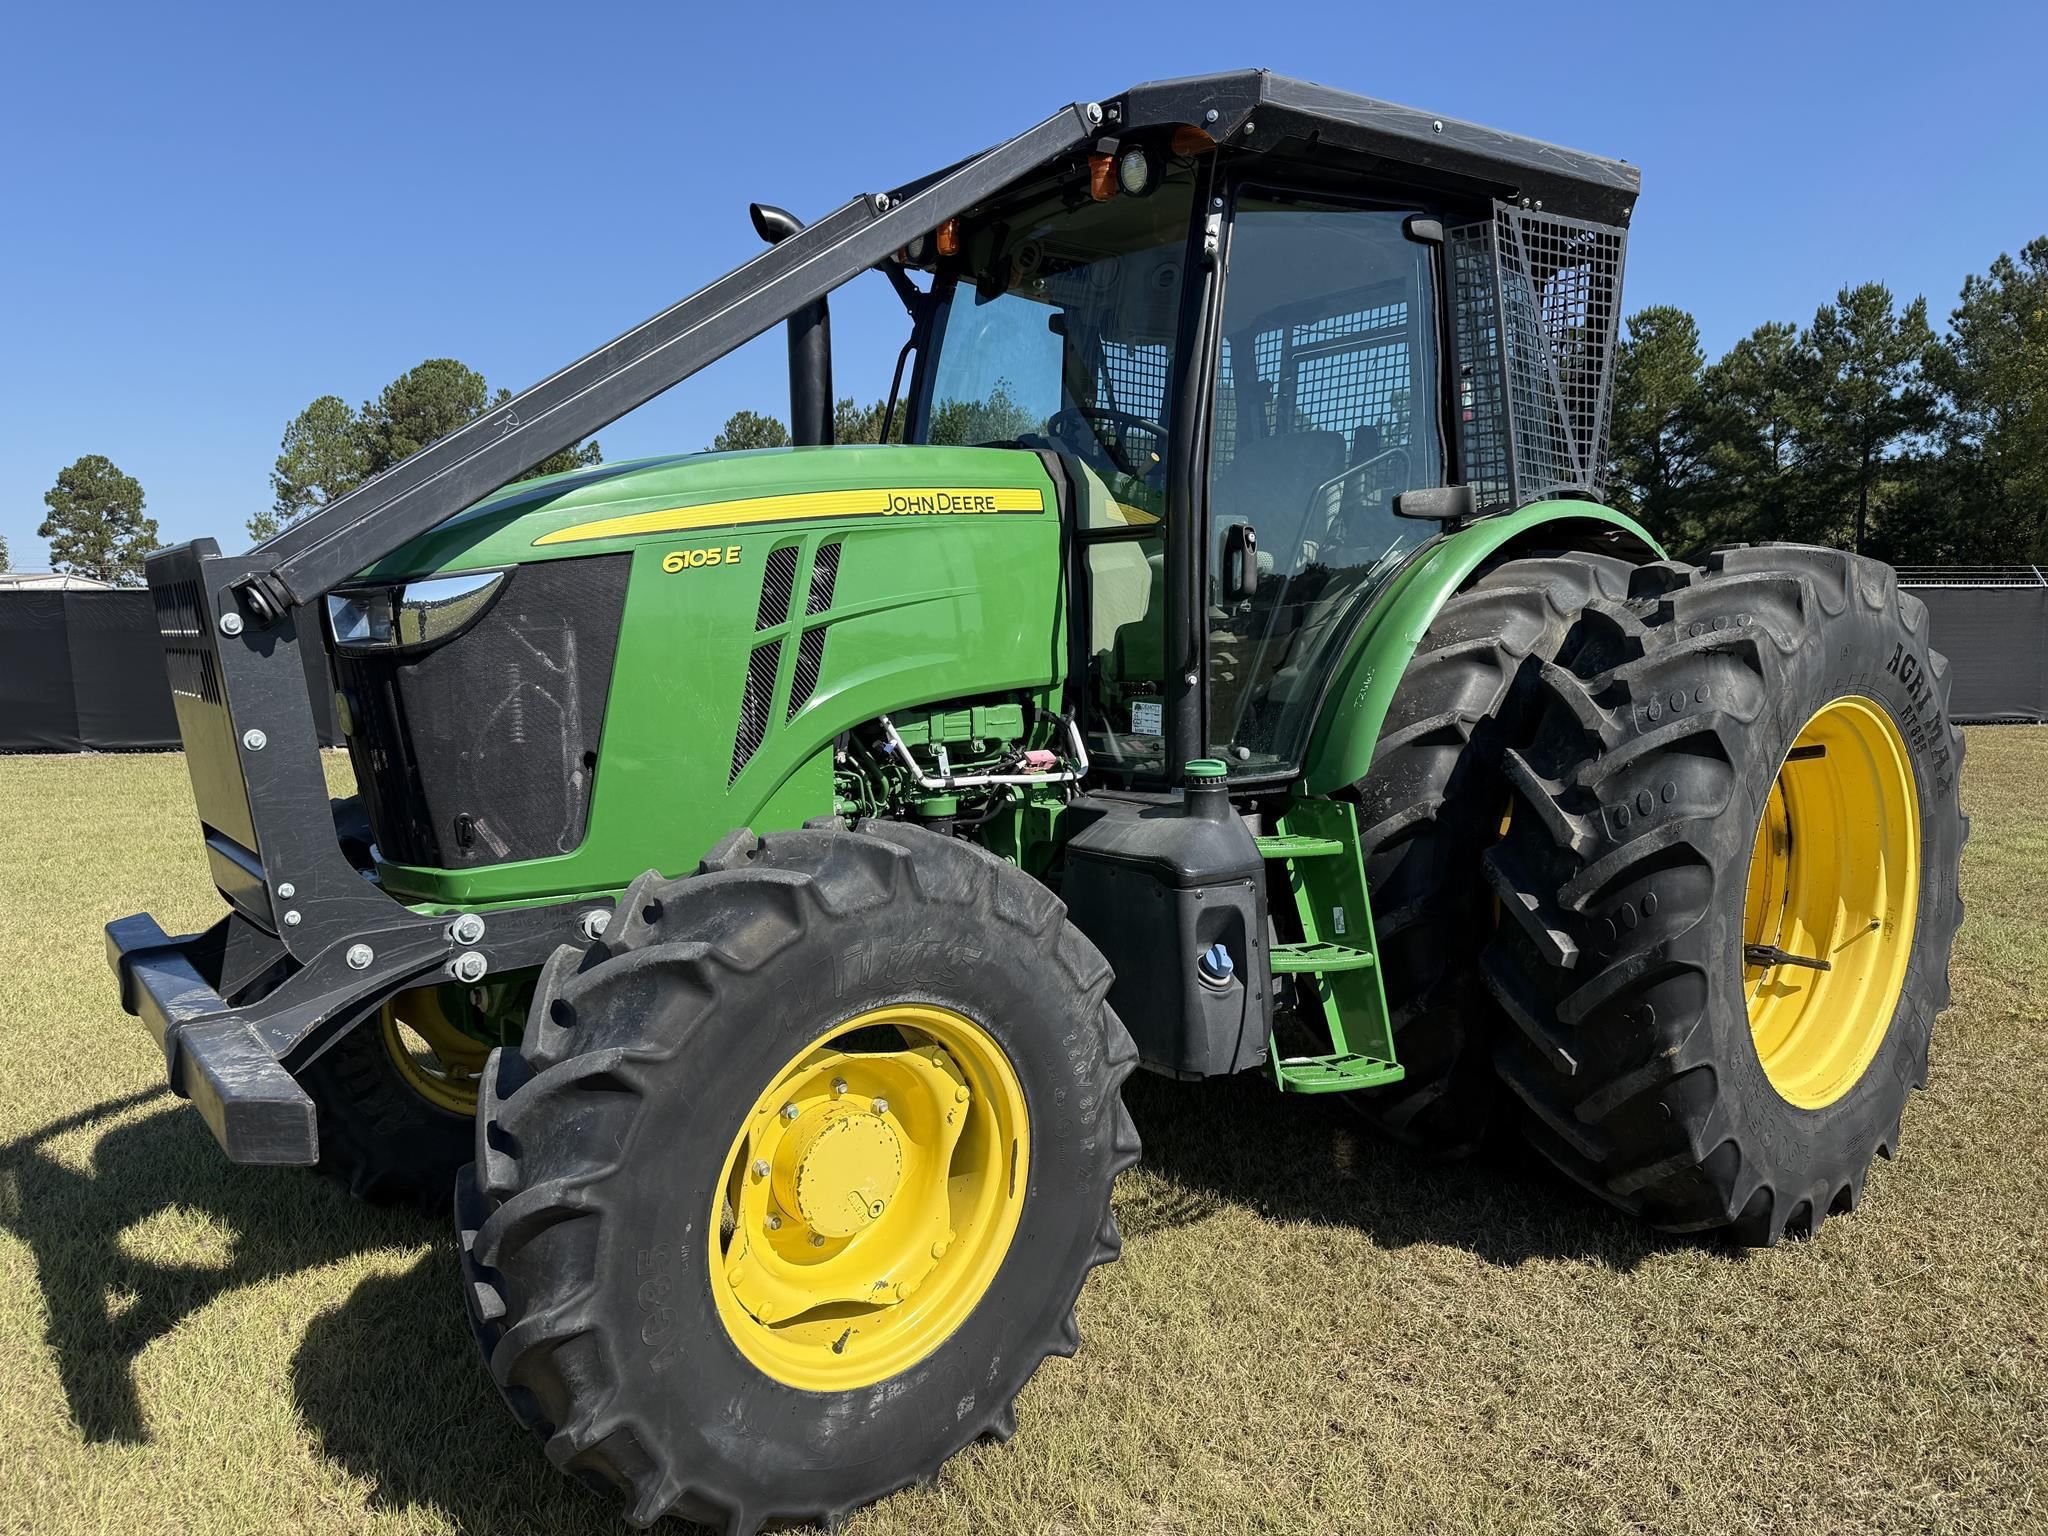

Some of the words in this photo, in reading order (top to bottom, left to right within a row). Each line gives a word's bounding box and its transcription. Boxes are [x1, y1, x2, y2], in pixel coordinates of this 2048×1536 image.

[883, 493, 935, 512] JOHN
[937, 493, 997, 511] DEERE
[1885, 642, 1935, 717] AGRI
